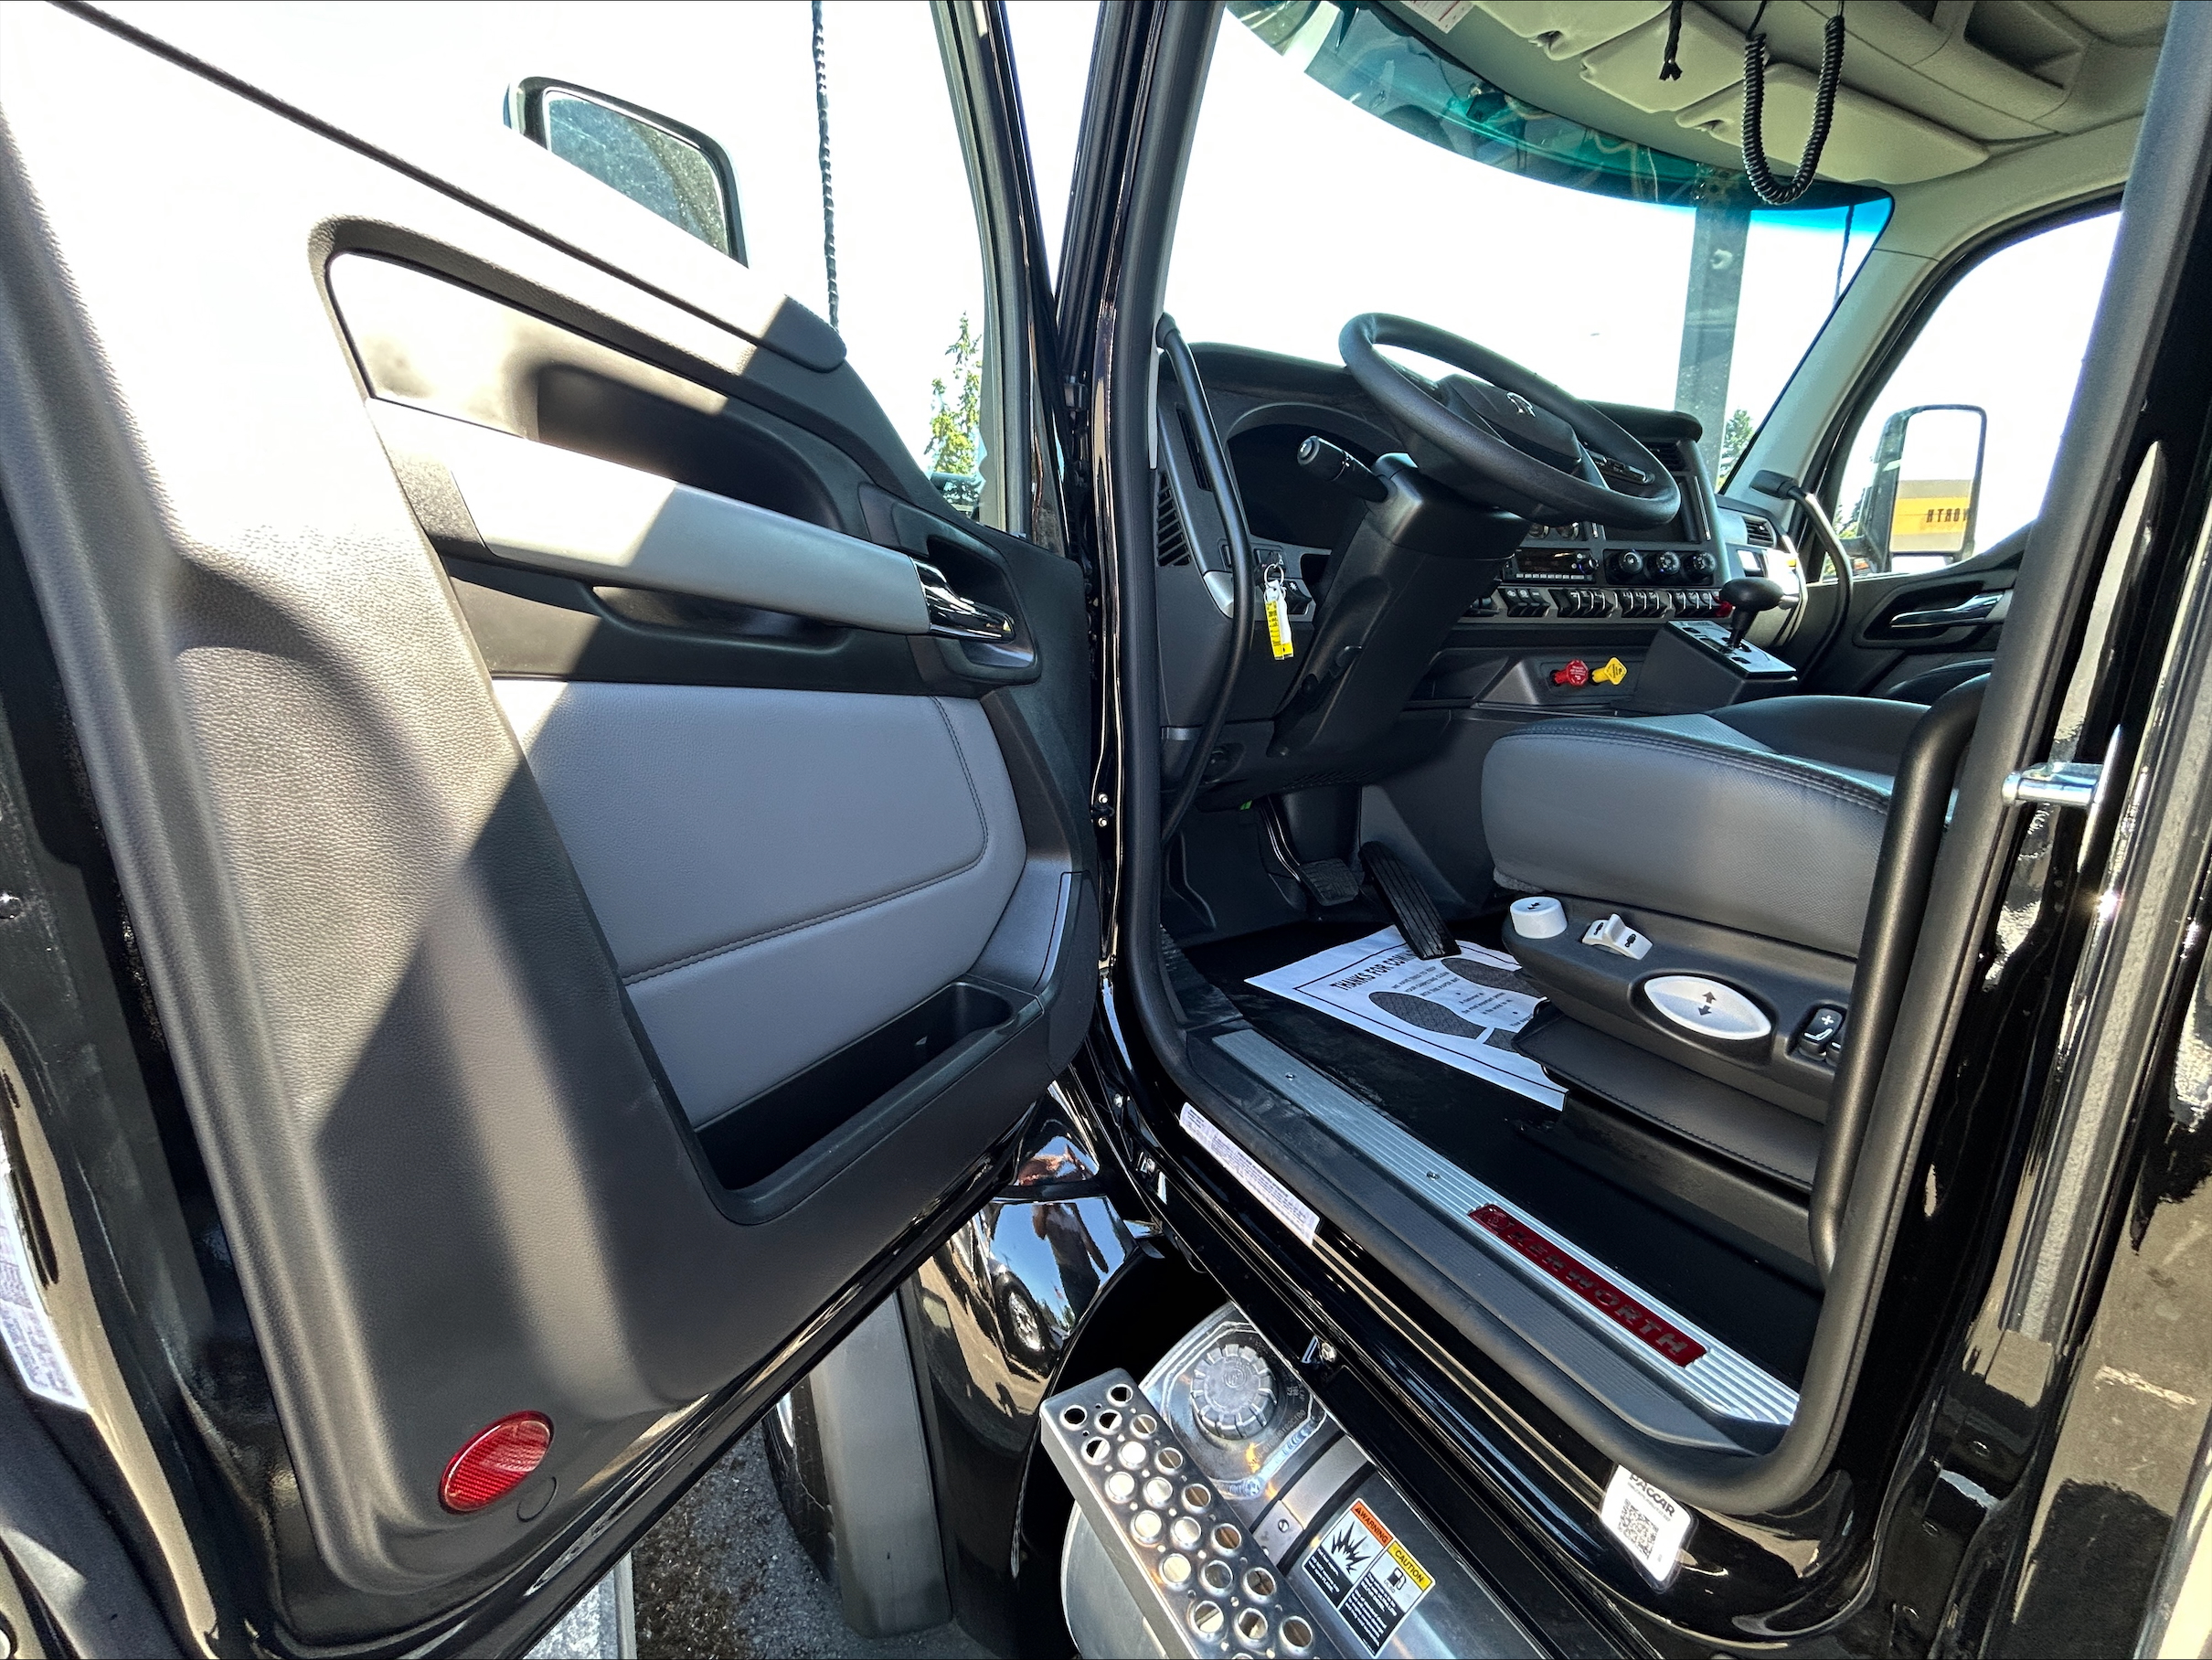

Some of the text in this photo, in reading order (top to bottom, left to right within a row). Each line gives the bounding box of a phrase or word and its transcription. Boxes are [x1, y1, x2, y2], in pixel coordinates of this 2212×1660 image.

[1330, 972, 1376, 990] THANKS
[1365, 963, 1394, 976] FOR
[1507, 1229, 1688, 1355] KENWORTH
[1629, 1474, 1675, 1517] PACCAR
[1361, 1513, 1388, 1543] WARNING
[1395, 1550, 1424, 1582] CAUTION
